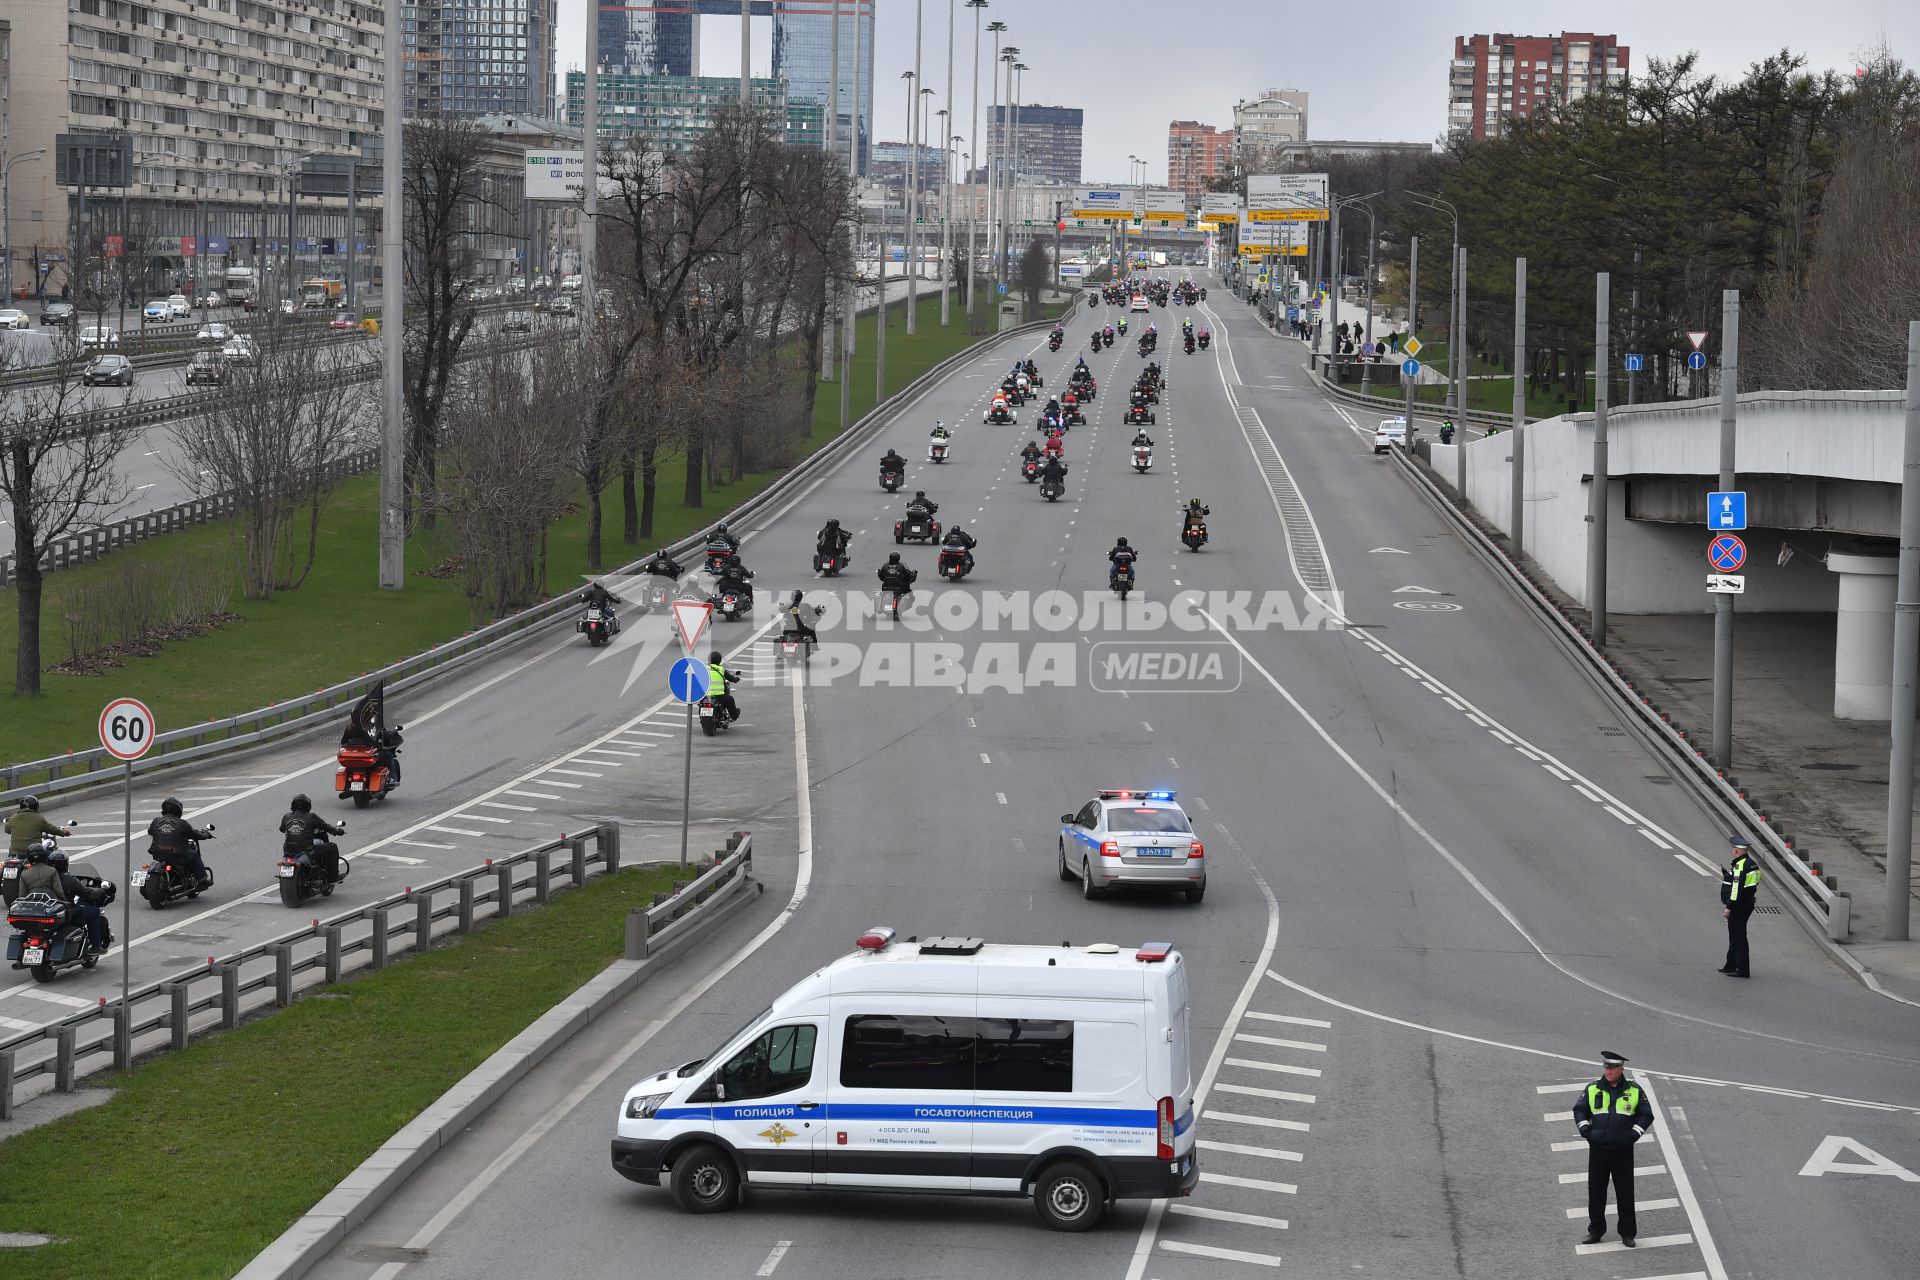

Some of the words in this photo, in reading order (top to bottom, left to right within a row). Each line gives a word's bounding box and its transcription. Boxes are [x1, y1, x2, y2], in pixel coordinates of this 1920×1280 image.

[111, 714, 145, 744] 60
[734, 1107, 794, 1118] ПОЛИЦИЯ
[914, 1108, 1034, 1120] ГОСАВТОИНСПЕКЦИЯ
